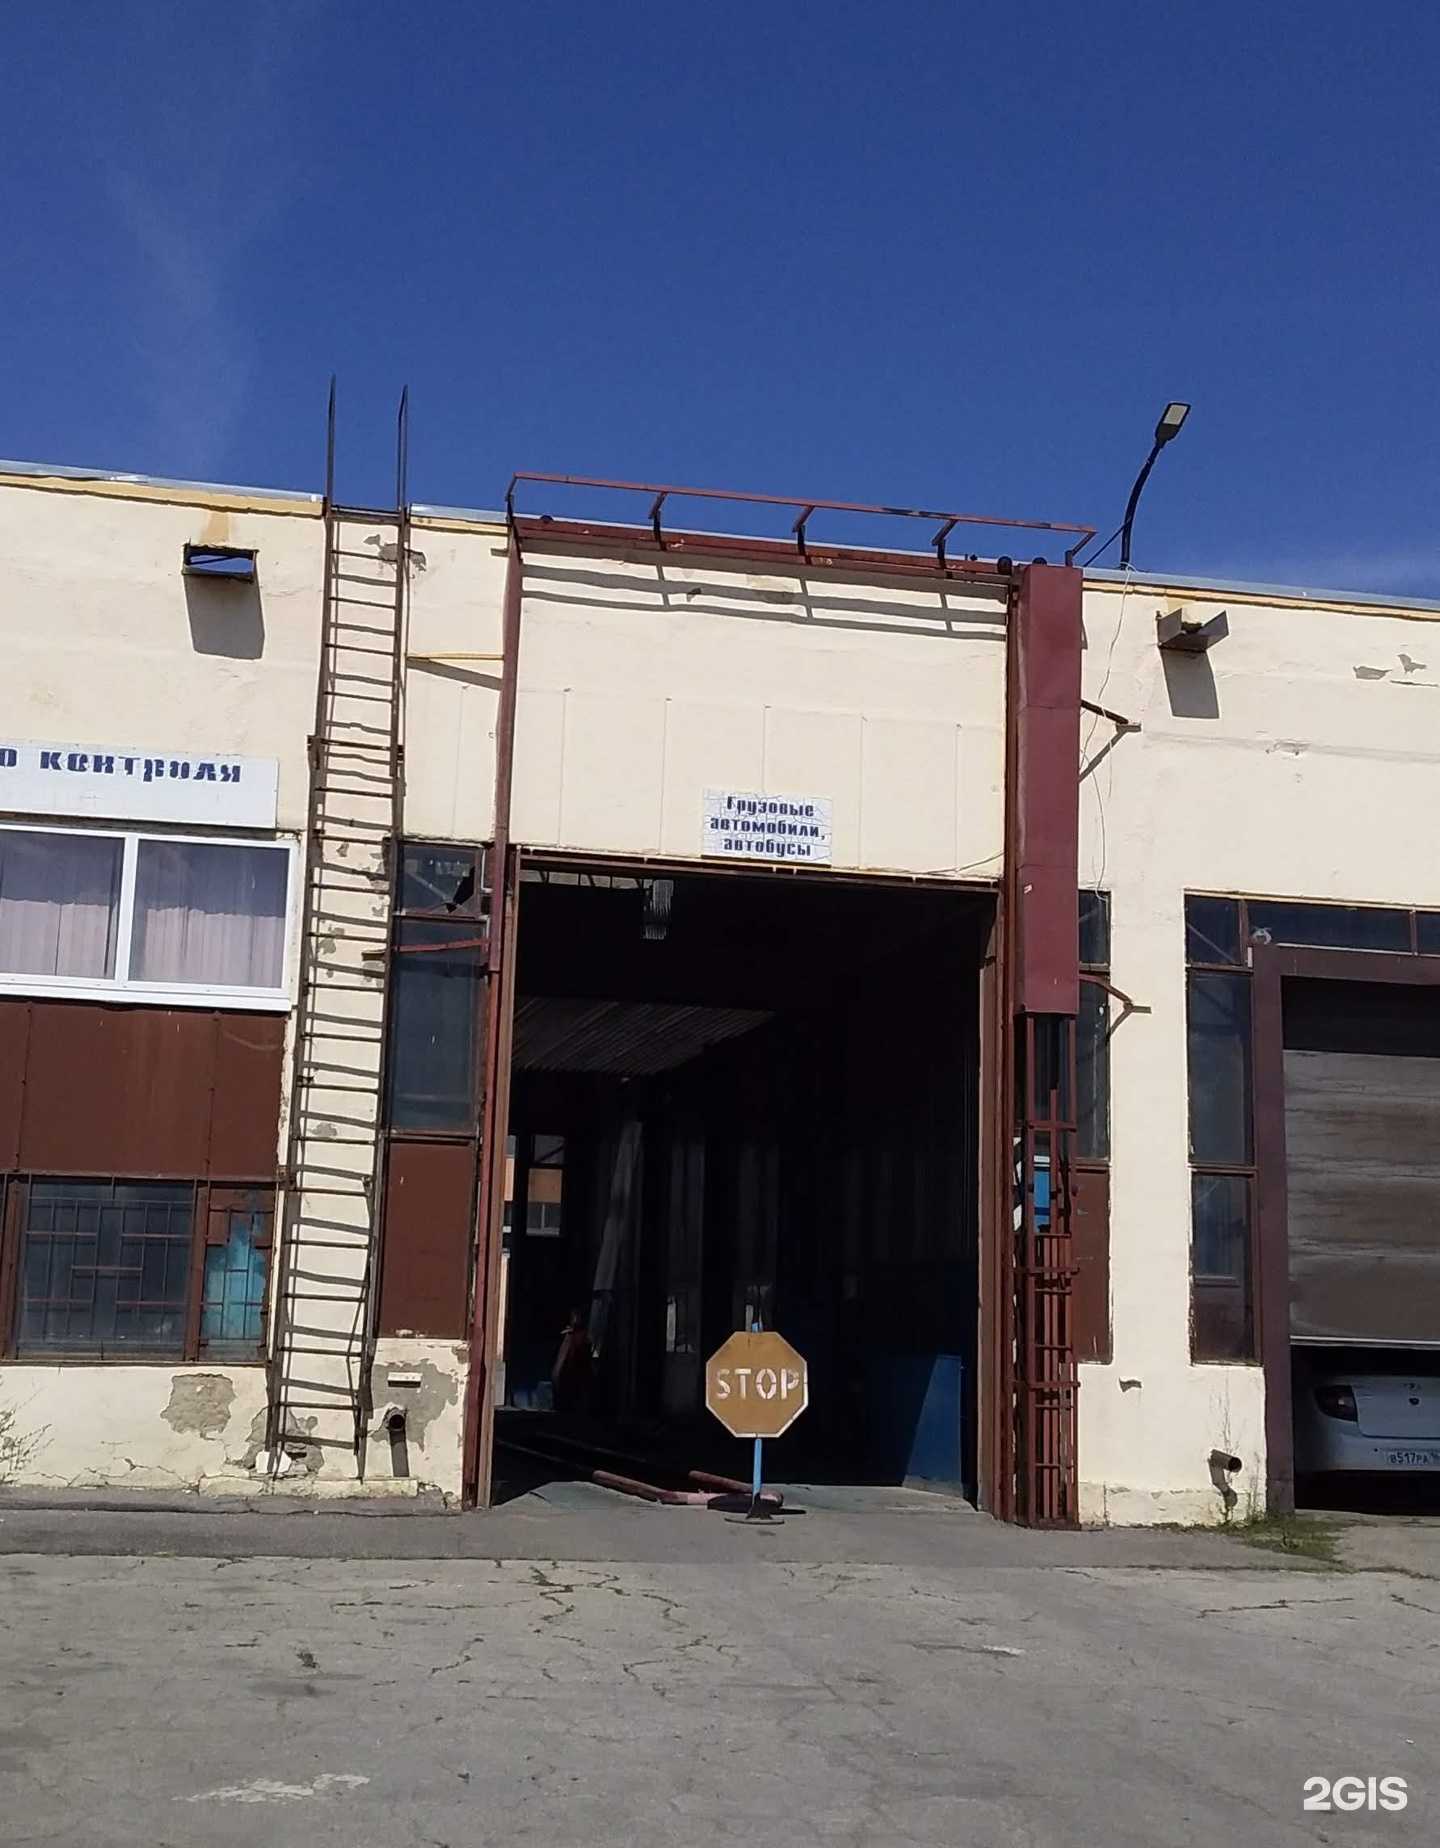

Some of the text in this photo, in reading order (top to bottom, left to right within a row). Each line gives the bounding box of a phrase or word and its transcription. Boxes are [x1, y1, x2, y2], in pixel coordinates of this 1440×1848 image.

[727, 796, 814, 817] Грузовые
[710, 817, 825, 840] автомобили,
[724, 838, 811, 857] автобусы
[716, 1368, 800, 1400] STOP
